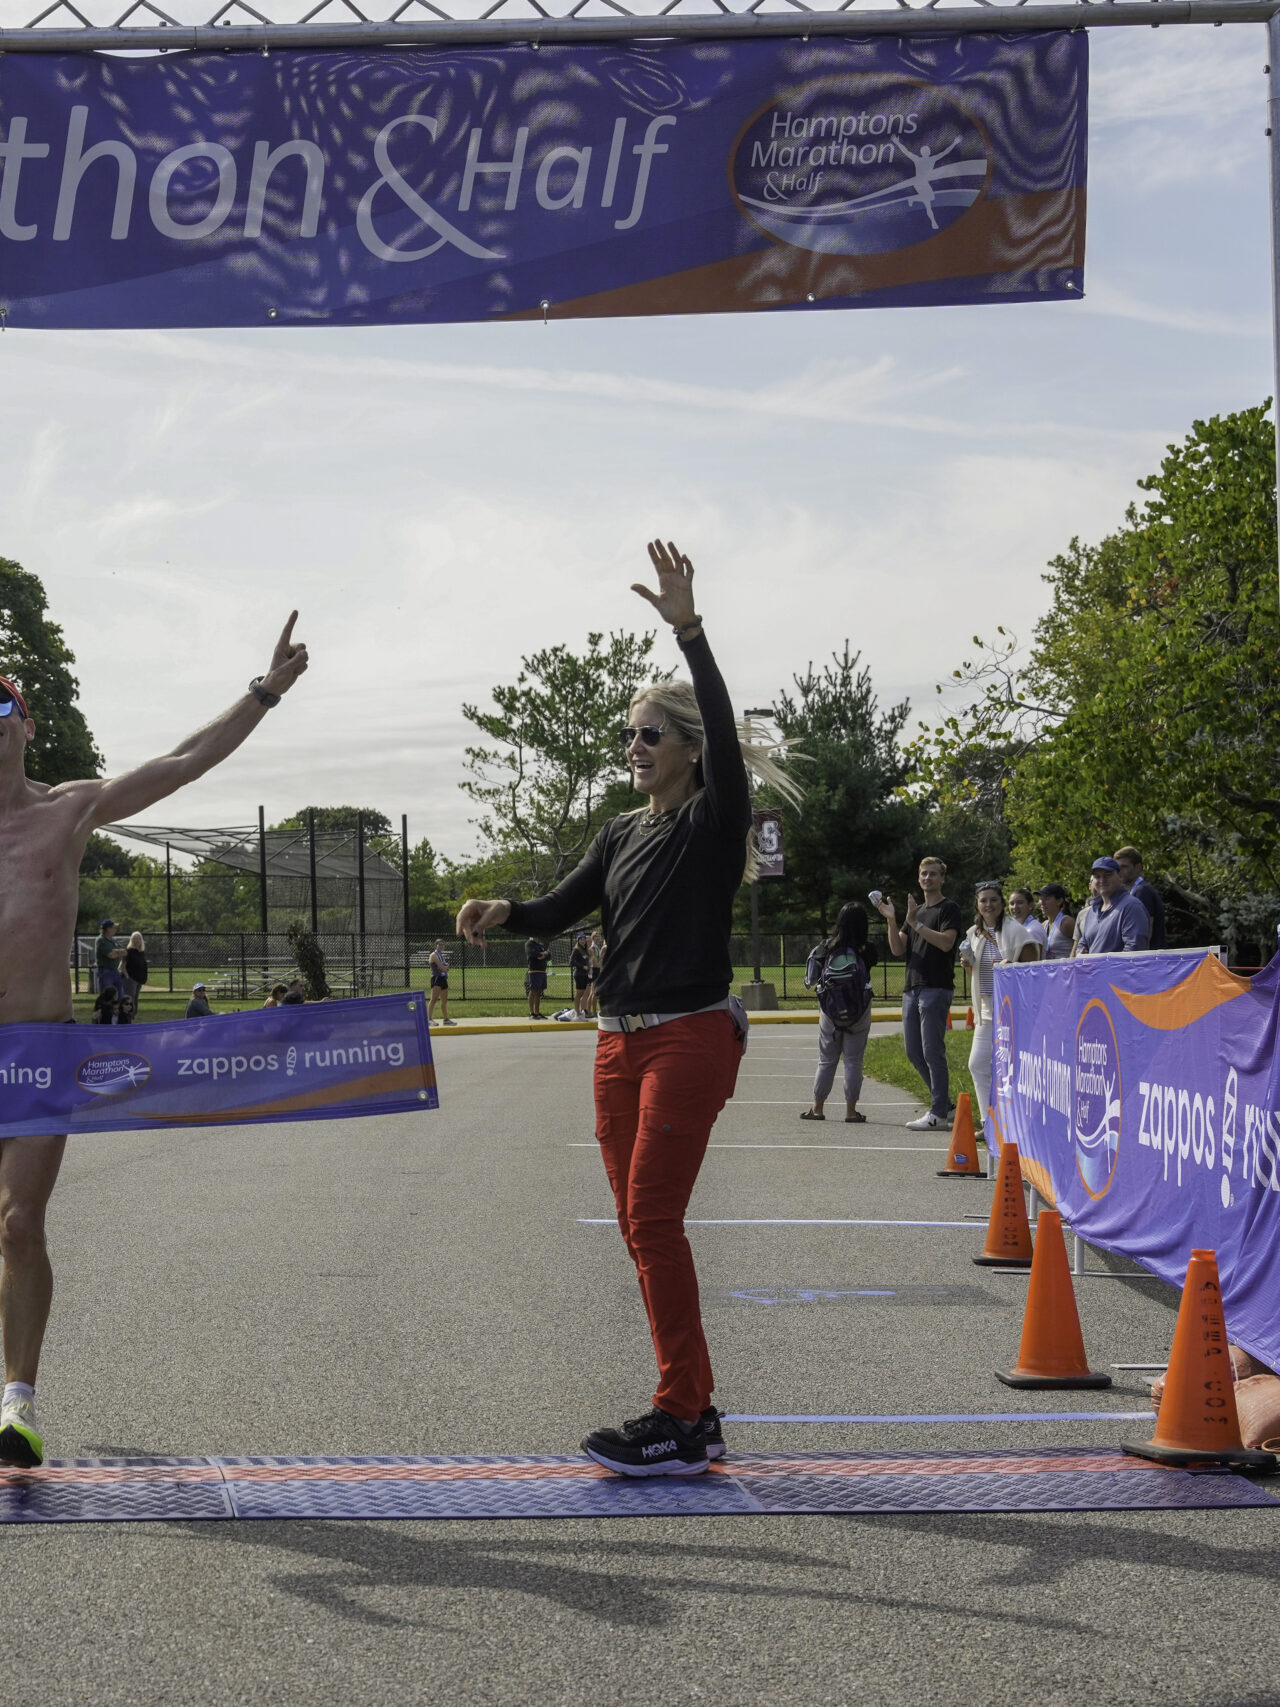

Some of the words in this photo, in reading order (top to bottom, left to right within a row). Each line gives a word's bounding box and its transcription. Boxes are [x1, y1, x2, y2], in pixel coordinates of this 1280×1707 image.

[770, 111, 919, 143] Hamptons
[750, 139, 895, 168] Marathon
[457, 115, 677, 230] Half
[782, 171, 824, 195] Half
[87, 1058, 130, 1069] Hamptons
[177, 1053, 279, 1080] zappos
[305, 1040, 405, 1068] running
[1078, 1035, 1108, 1069] Hamptons
[81, 1065, 125, 1076] Marathon
[1075, 1065, 1104, 1096] Marathon
[1017, 1050, 1042, 1118] zappos
[1046, 1040, 1072, 1143] running
[1138, 1081, 1216, 1187] zappos
[641, 1439, 678, 1459] HOKA
